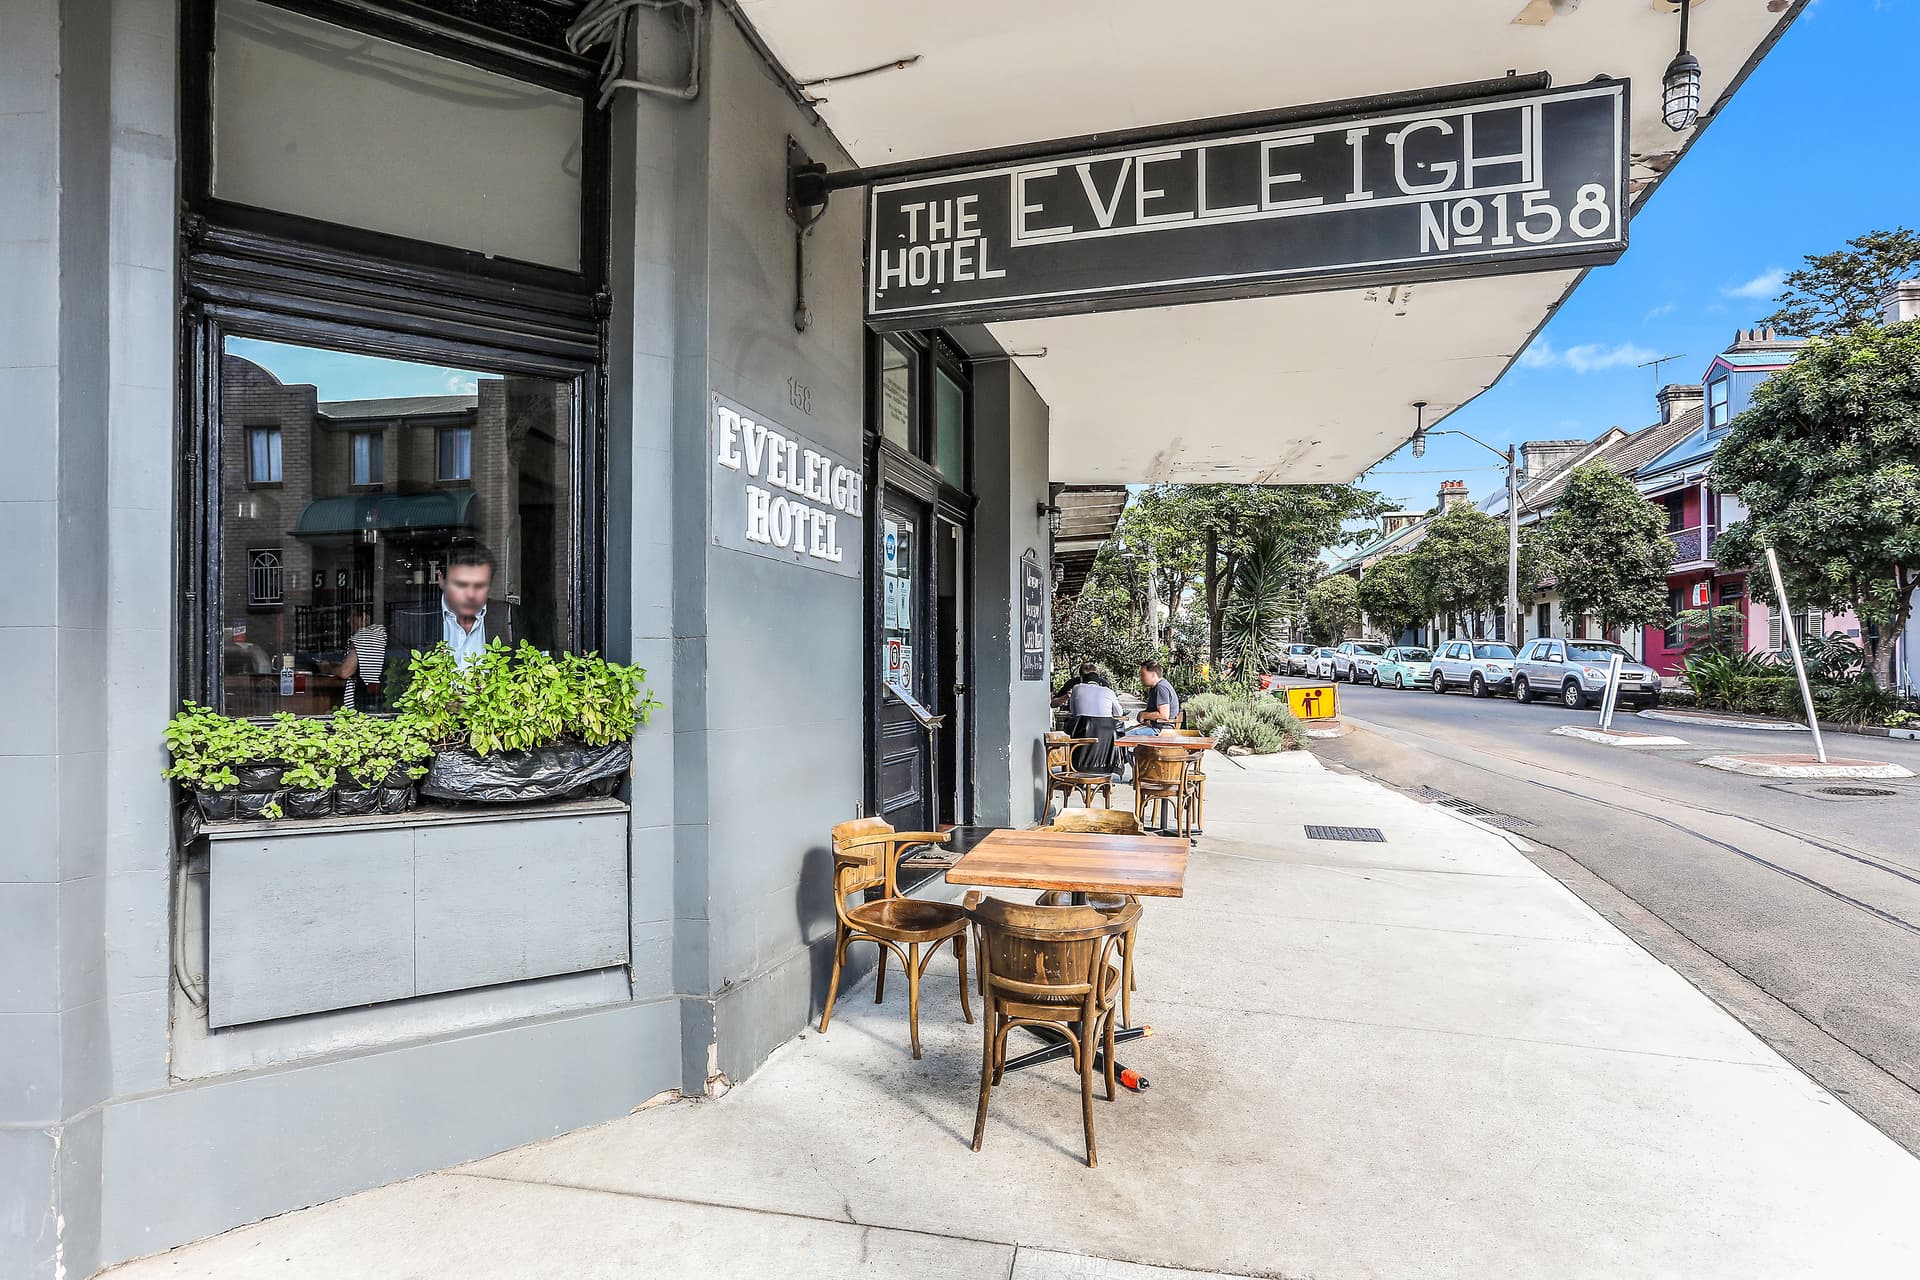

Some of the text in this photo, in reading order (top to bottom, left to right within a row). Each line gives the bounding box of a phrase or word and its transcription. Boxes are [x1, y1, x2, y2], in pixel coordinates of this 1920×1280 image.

[1017, 105, 1533, 240] EVELEIGH
[900, 194, 982, 244] THE
[878, 237, 1007, 290] HOTEL
[787, 377, 812, 416] 158
[717, 406, 863, 518] EVELEIGH
[745, 484, 843, 563] HOTEL
